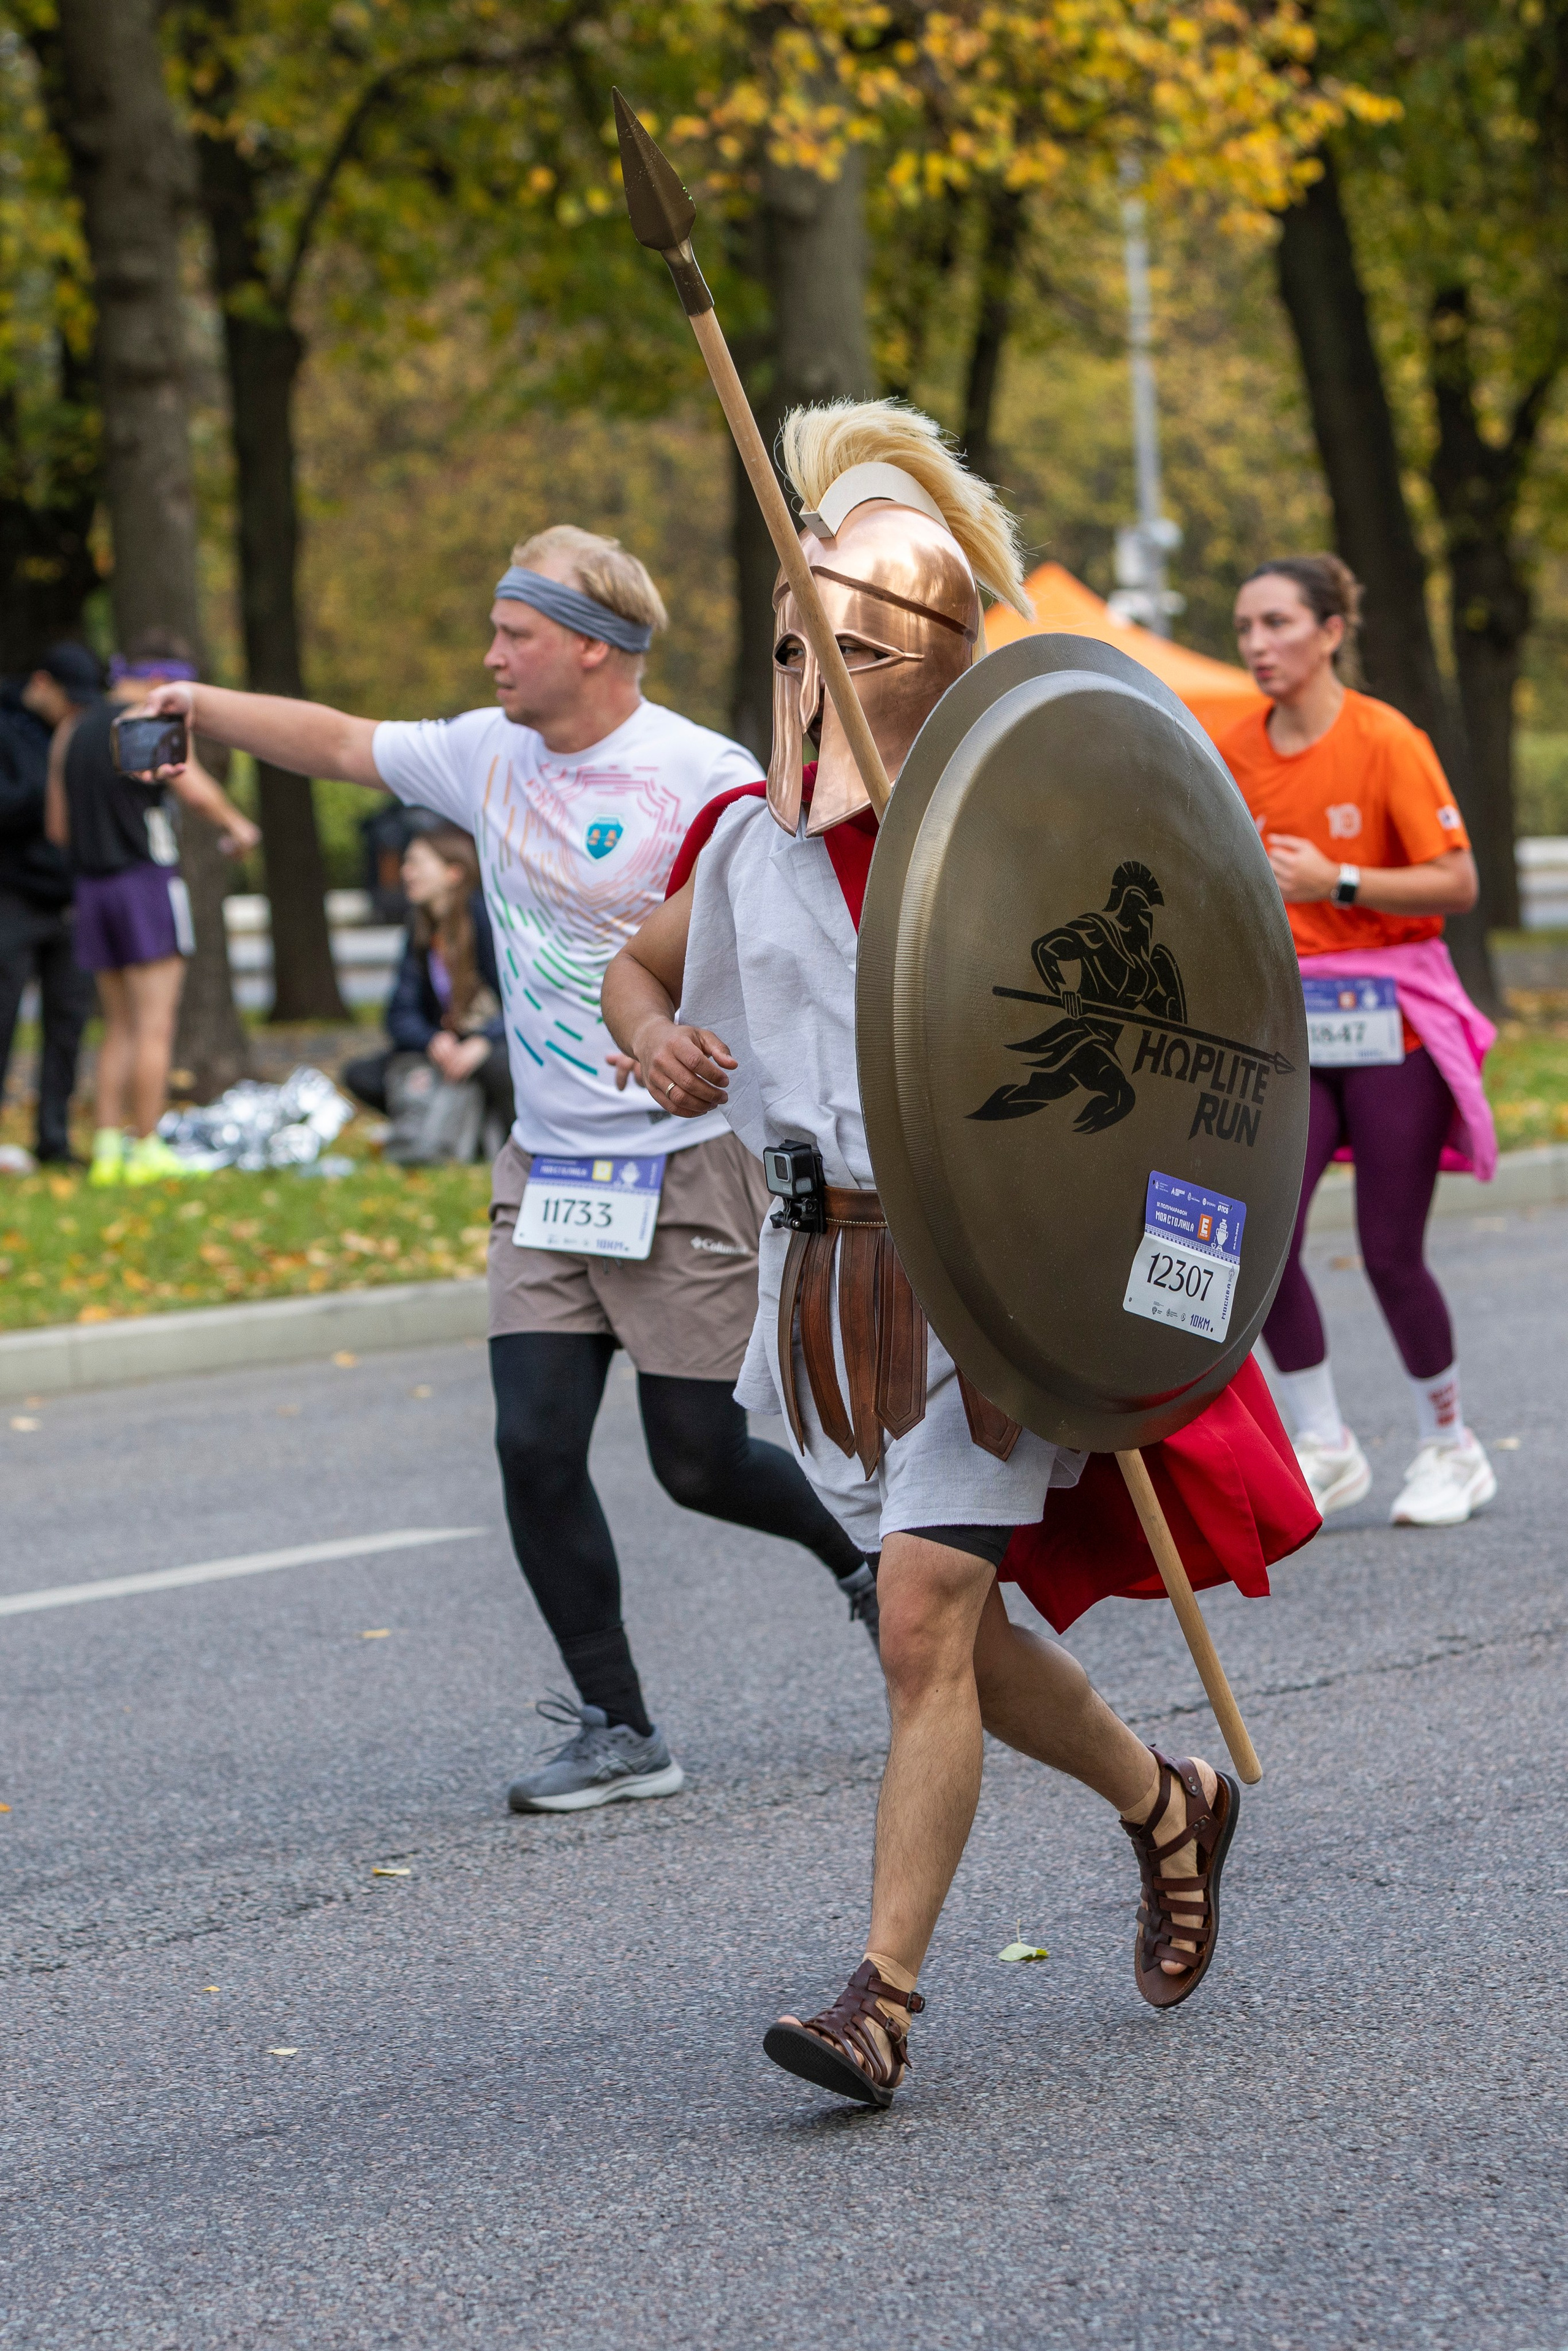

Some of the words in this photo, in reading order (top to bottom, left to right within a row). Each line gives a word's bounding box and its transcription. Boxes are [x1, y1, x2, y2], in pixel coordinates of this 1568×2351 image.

[1188, 1092, 1262, 1147] RUN
[542, 1198, 613, 1228] 11733
[1155, 1210, 1167, 1223] МОЯ
[1167, 1215, 1194, 1232] СТОЛИЦА
[1160, 1202, 1188, 1217] ПОЛУМАРАФОН
[1147, 1252, 1214, 1302] 12307
[1221, 1283, 1231, 1320] МОСКВА
